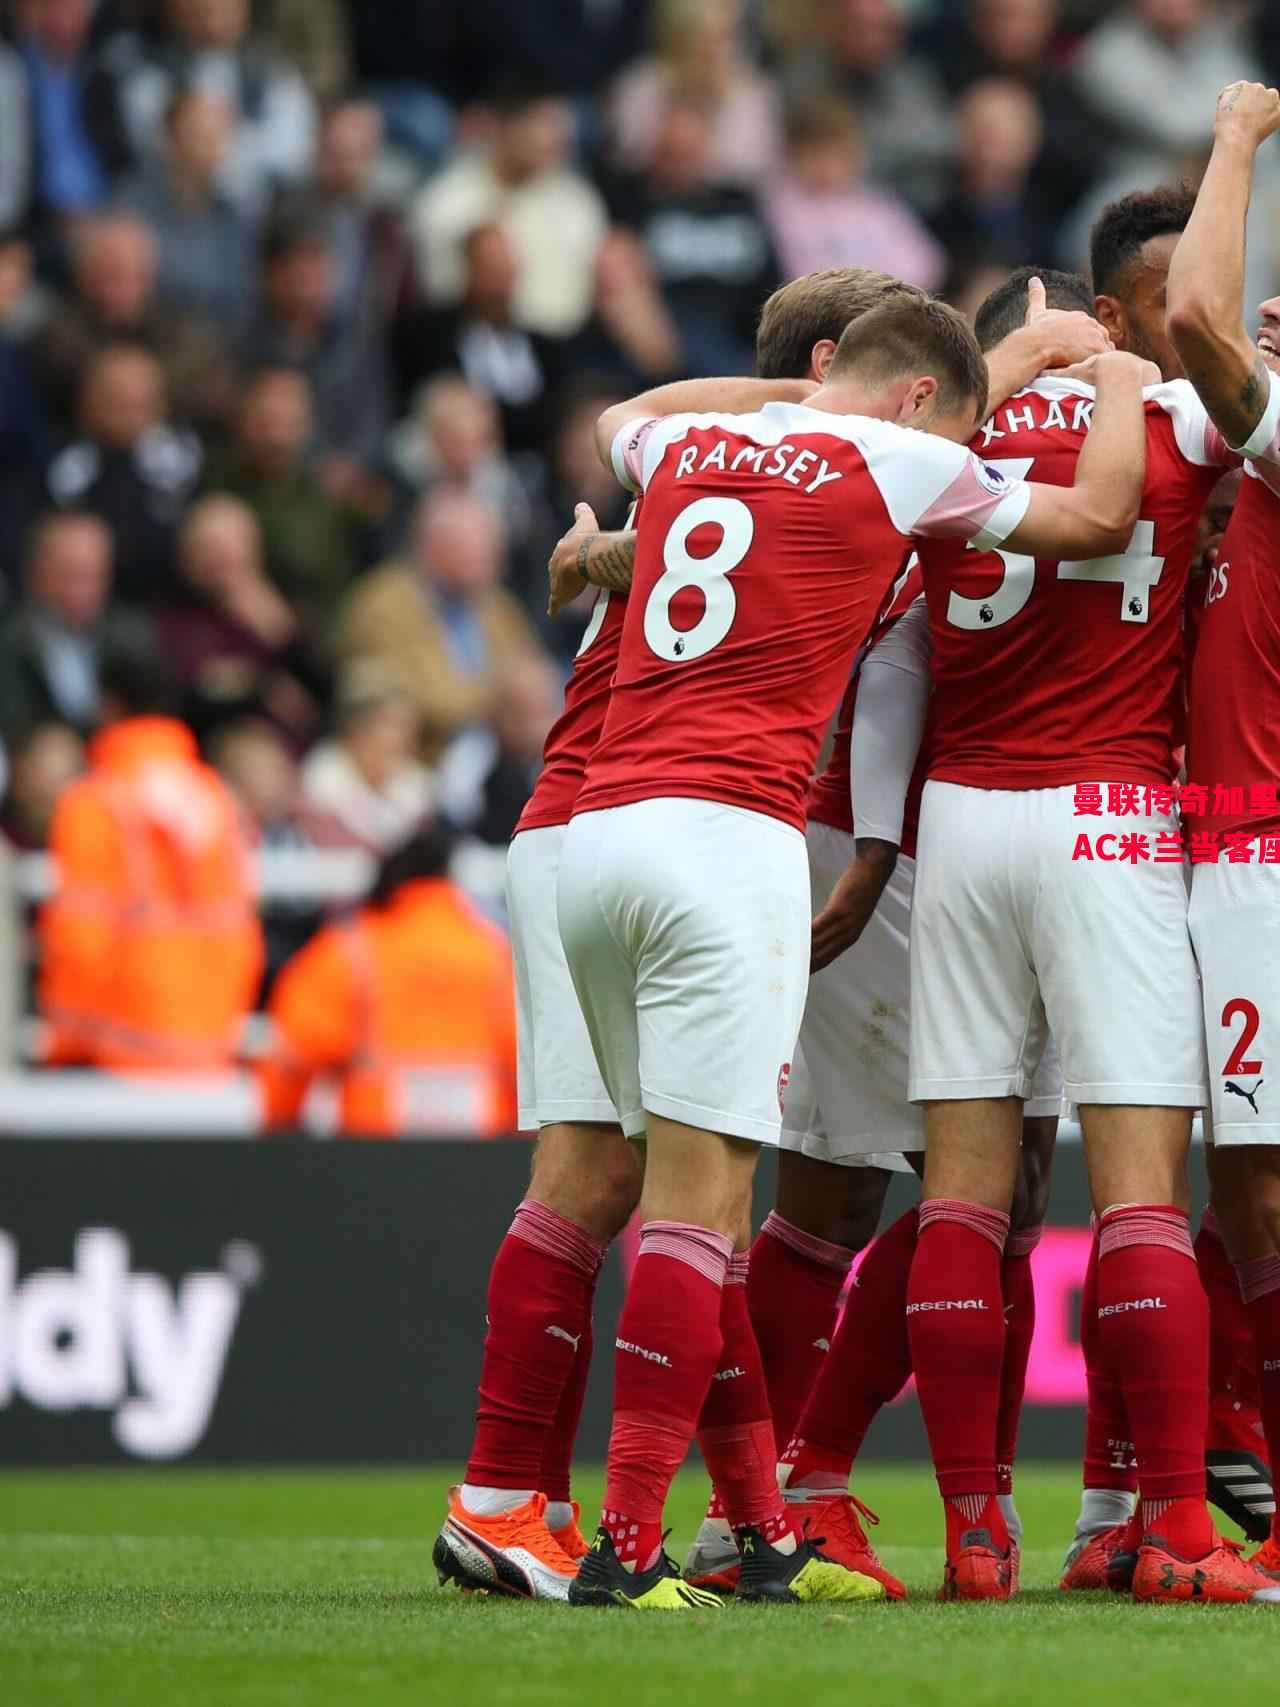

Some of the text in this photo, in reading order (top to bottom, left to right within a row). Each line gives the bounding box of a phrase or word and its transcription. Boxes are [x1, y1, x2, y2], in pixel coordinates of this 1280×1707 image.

[980, 400, 1096, 448] XHAK
[675, 440, 843, 494] RAMSEY
[643, 496, 755, 663] 8
[1222, 998, 1263, 1076] 2
[906, 1299, 989, 1316] ARSENAL
[0, 1226, 244, 1458] dy
